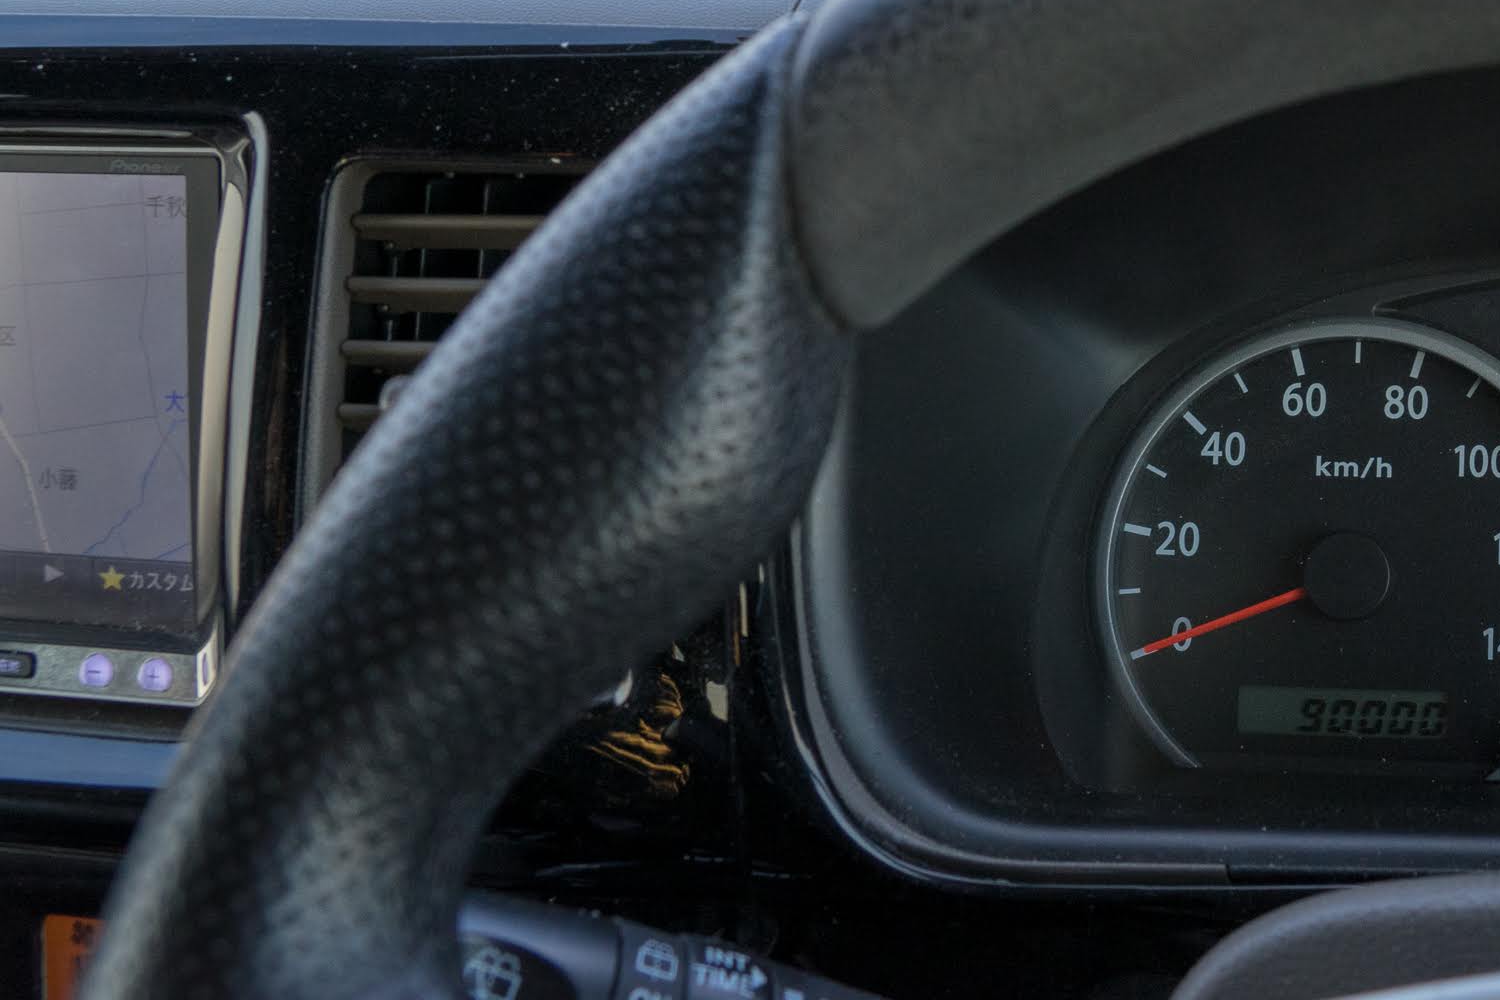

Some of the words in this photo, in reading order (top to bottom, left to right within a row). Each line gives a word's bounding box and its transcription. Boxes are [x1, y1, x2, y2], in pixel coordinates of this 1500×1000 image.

[1282, 383, 1327, 416] 60
[1384, 385, 1429, 419] 80
[1200, 432, 1246, 465] 40
[1315, 455, 1393, 480] km/h
[1155, 522, 1200, 557] 20
[1171, 616, 1192, 651] 0
